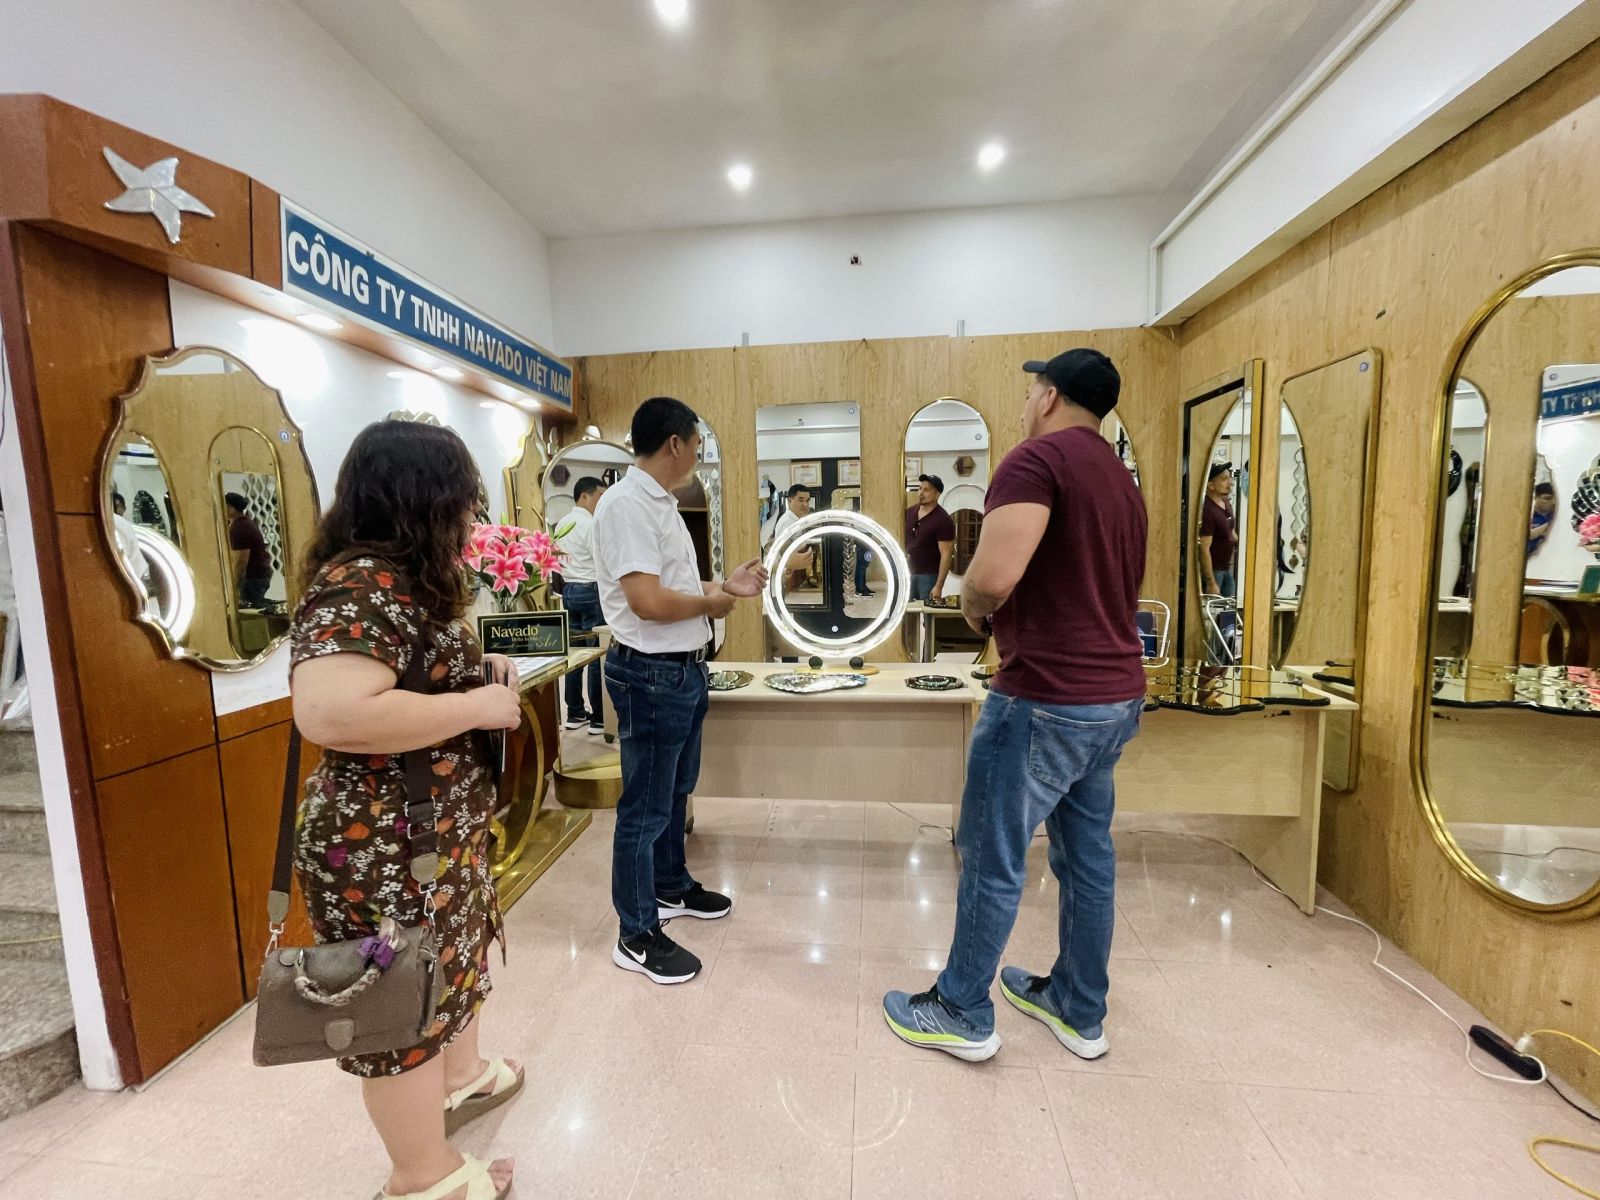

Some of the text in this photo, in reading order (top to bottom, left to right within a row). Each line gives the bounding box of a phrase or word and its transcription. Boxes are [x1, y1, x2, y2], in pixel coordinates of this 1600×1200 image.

[288, 231, 571, 398] CÔNG TY TNHH NAVADO VIỆT NAM
[491, 624, 540, 638] Navado
